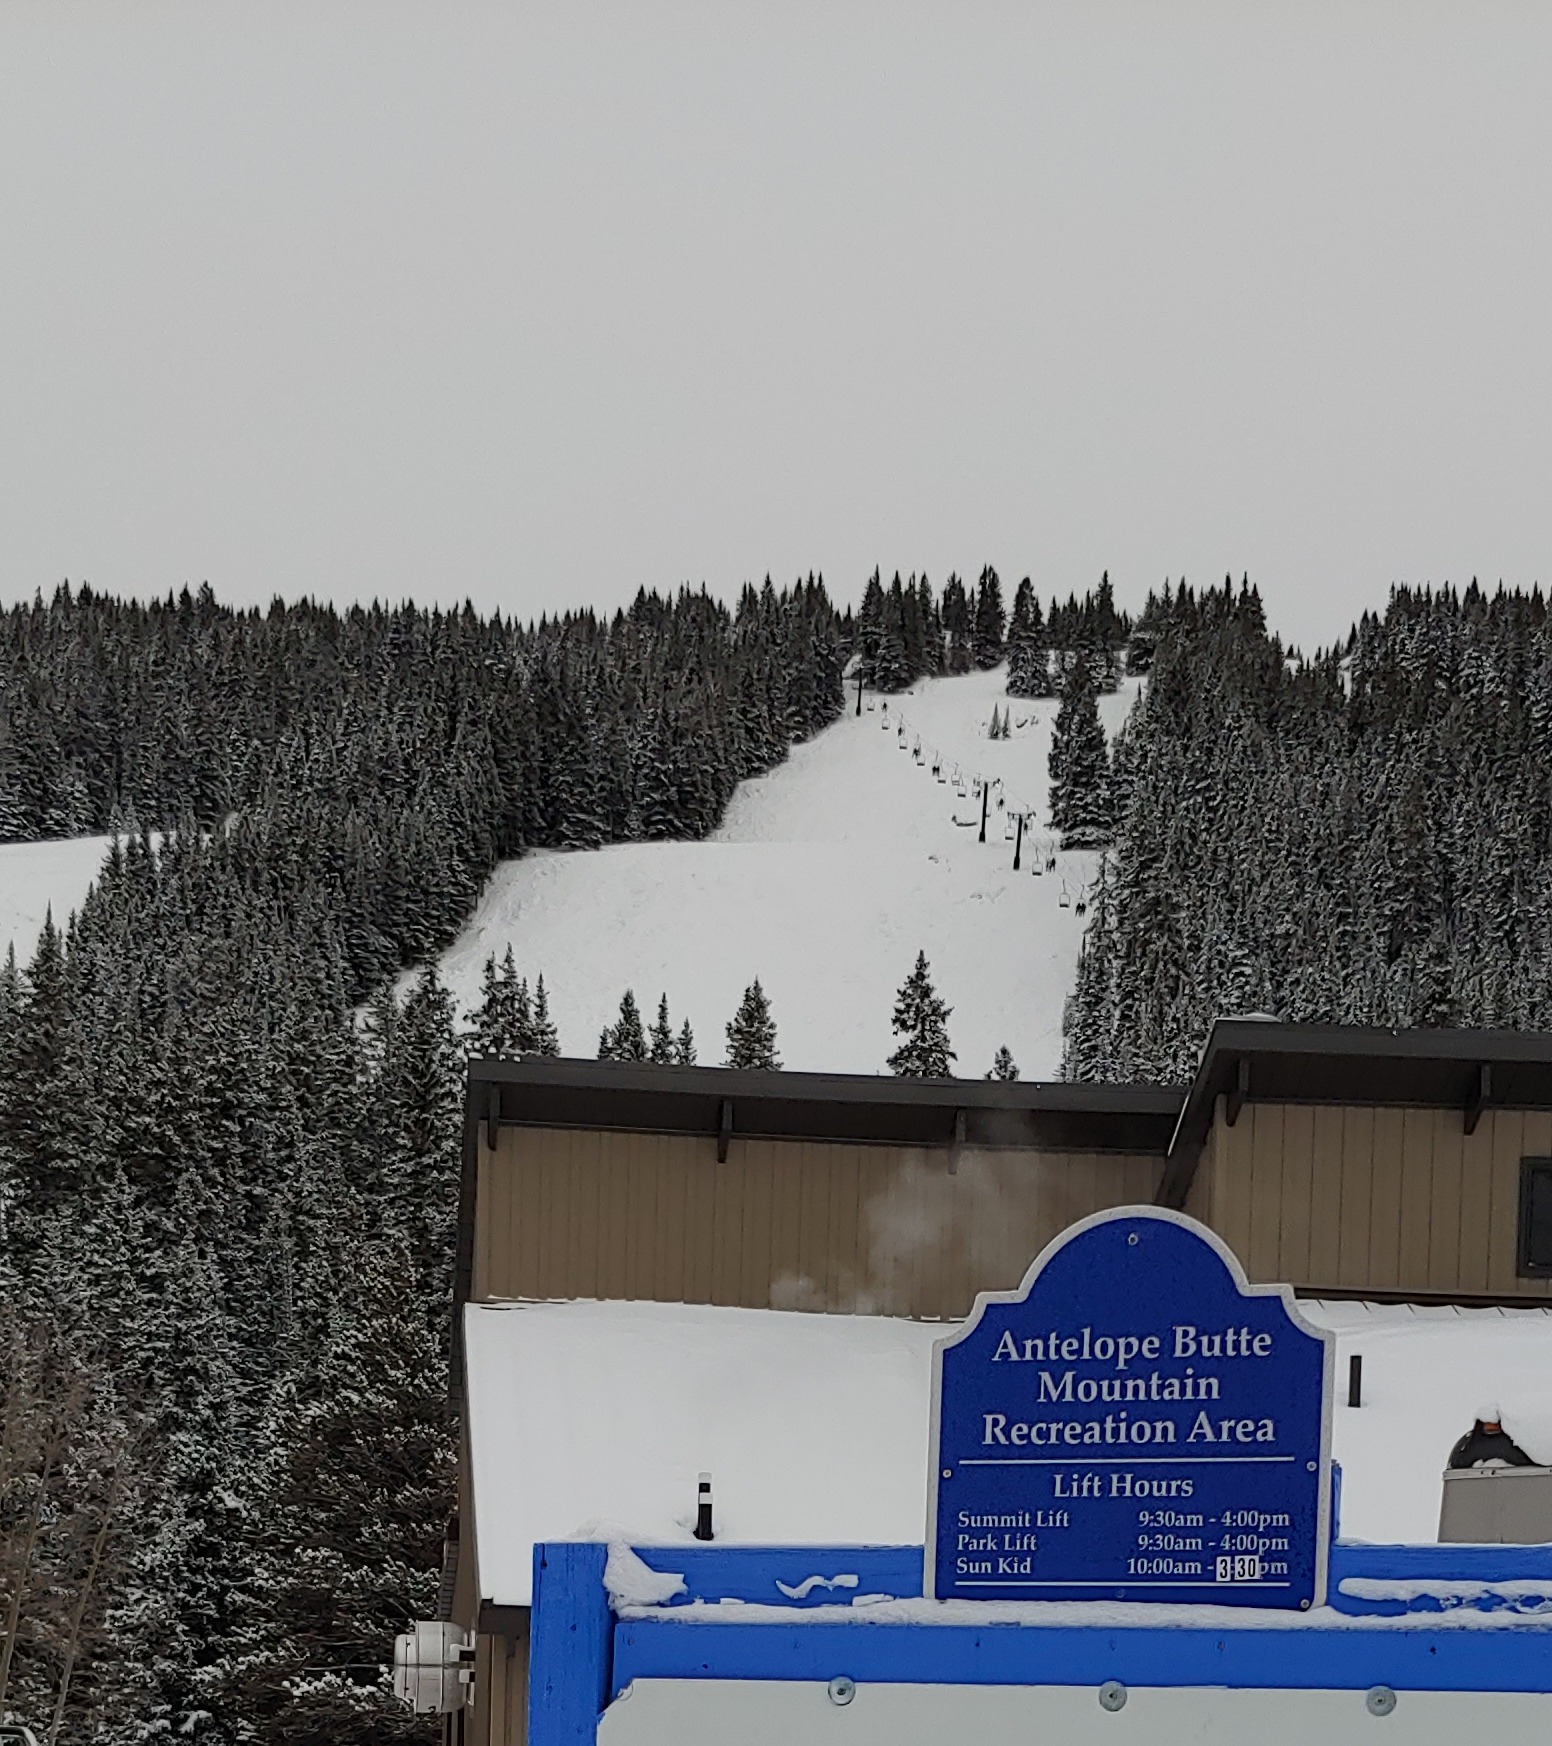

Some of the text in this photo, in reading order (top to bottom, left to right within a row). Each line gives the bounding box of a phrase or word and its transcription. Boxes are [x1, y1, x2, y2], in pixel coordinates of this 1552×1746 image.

[991, 1325, 1273, 1369] Antelope Butte
[1036, 1369, 1221, 1403] Mountain
[981, 1410, 1276, 1446] Recreation Area
[1053, 1473, 1194, 1498] Lift Hours
[957, 1509, 1032, 1529] Summit
[1036, 1510, 1070, 1528] Lift
[1137, 1510, 1204, 1528] 9:30am
[1220, 1510, 1290, 1533] 4:00pm
[956, 1533, 998, 1552] Park
[1002, 1533, 1038, 1552] Lift
[1137, 1534, 1203, 1552] 9:30am
[1219, 1534, 1290, 1556] 4:00pm
[955, 1557, 993, 1575] Sun
[997, 1557, 1032, 1575] Kid
[1126, 1557, 1202, 1576] 10:00am
